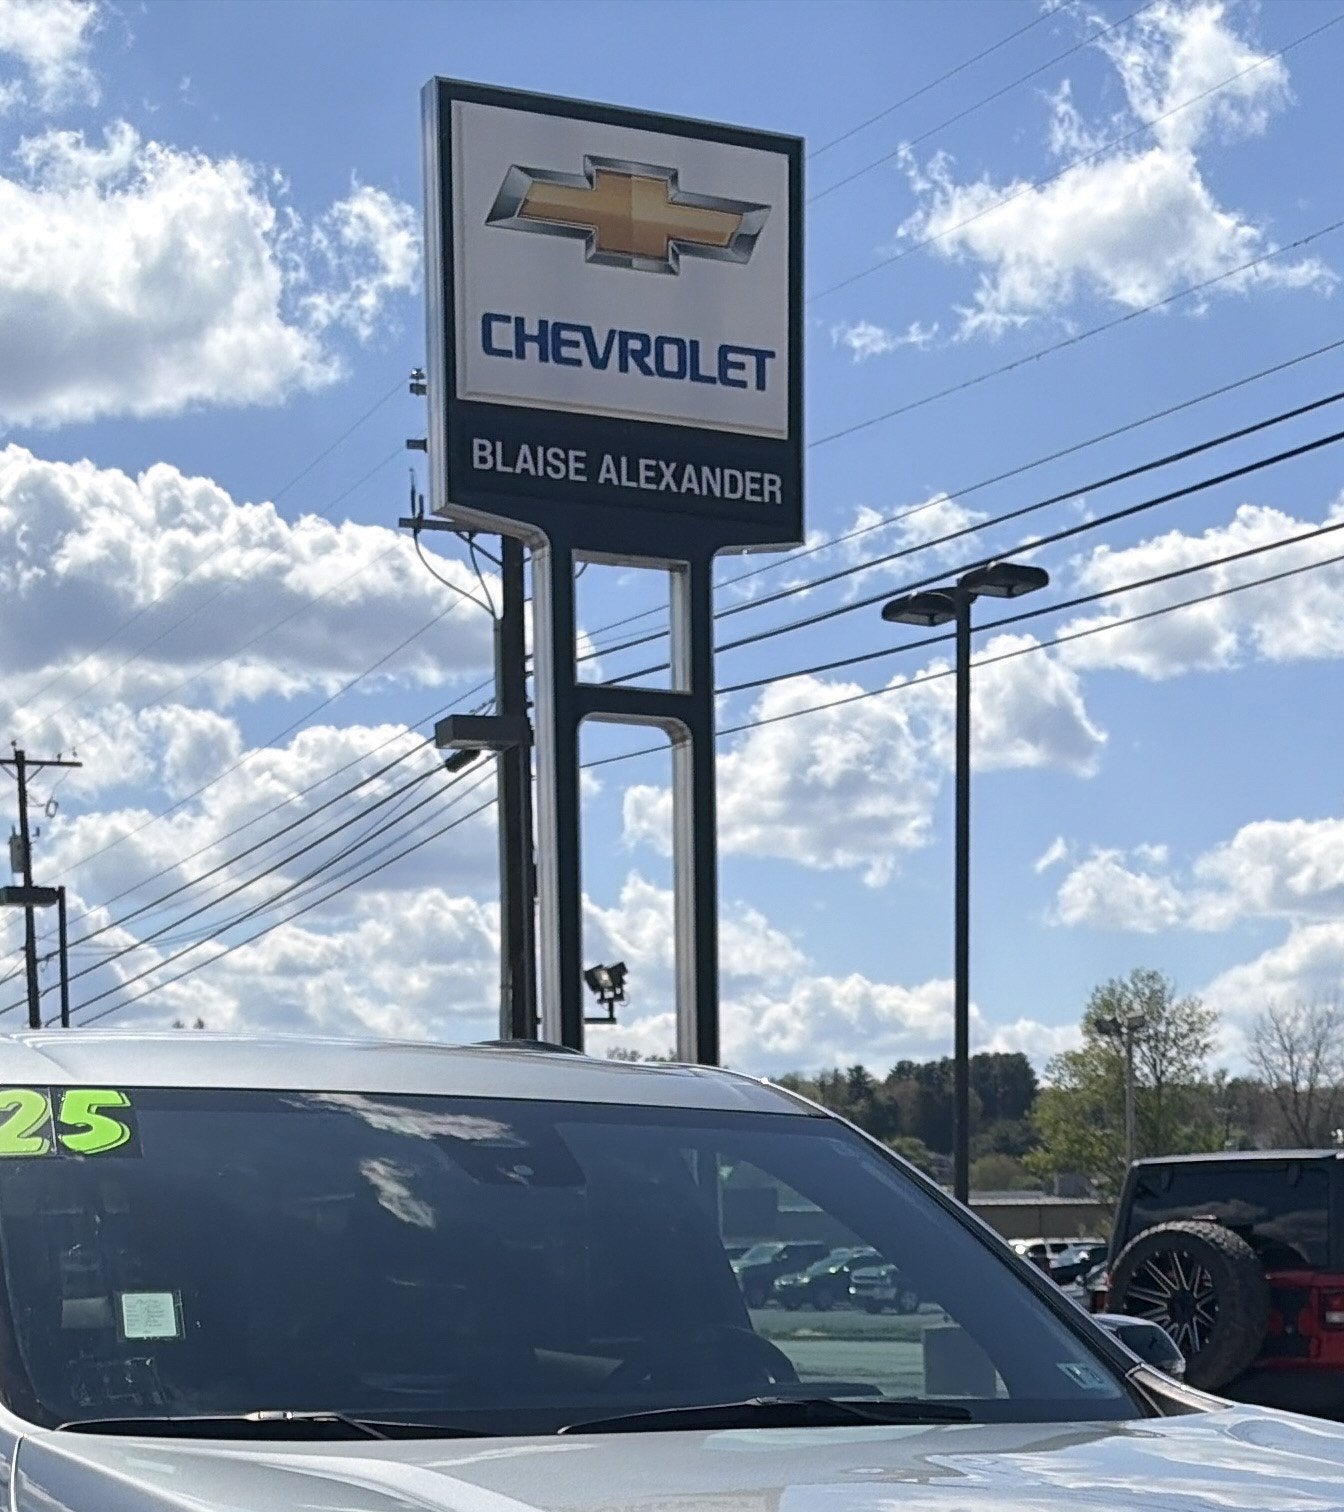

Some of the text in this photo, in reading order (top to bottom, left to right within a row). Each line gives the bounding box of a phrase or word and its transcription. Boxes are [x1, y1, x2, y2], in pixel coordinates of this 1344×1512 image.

[481, 312, 776, 392] CHEVROLET
[472, 438, 783, 504] BLAISE ALEXANDER
